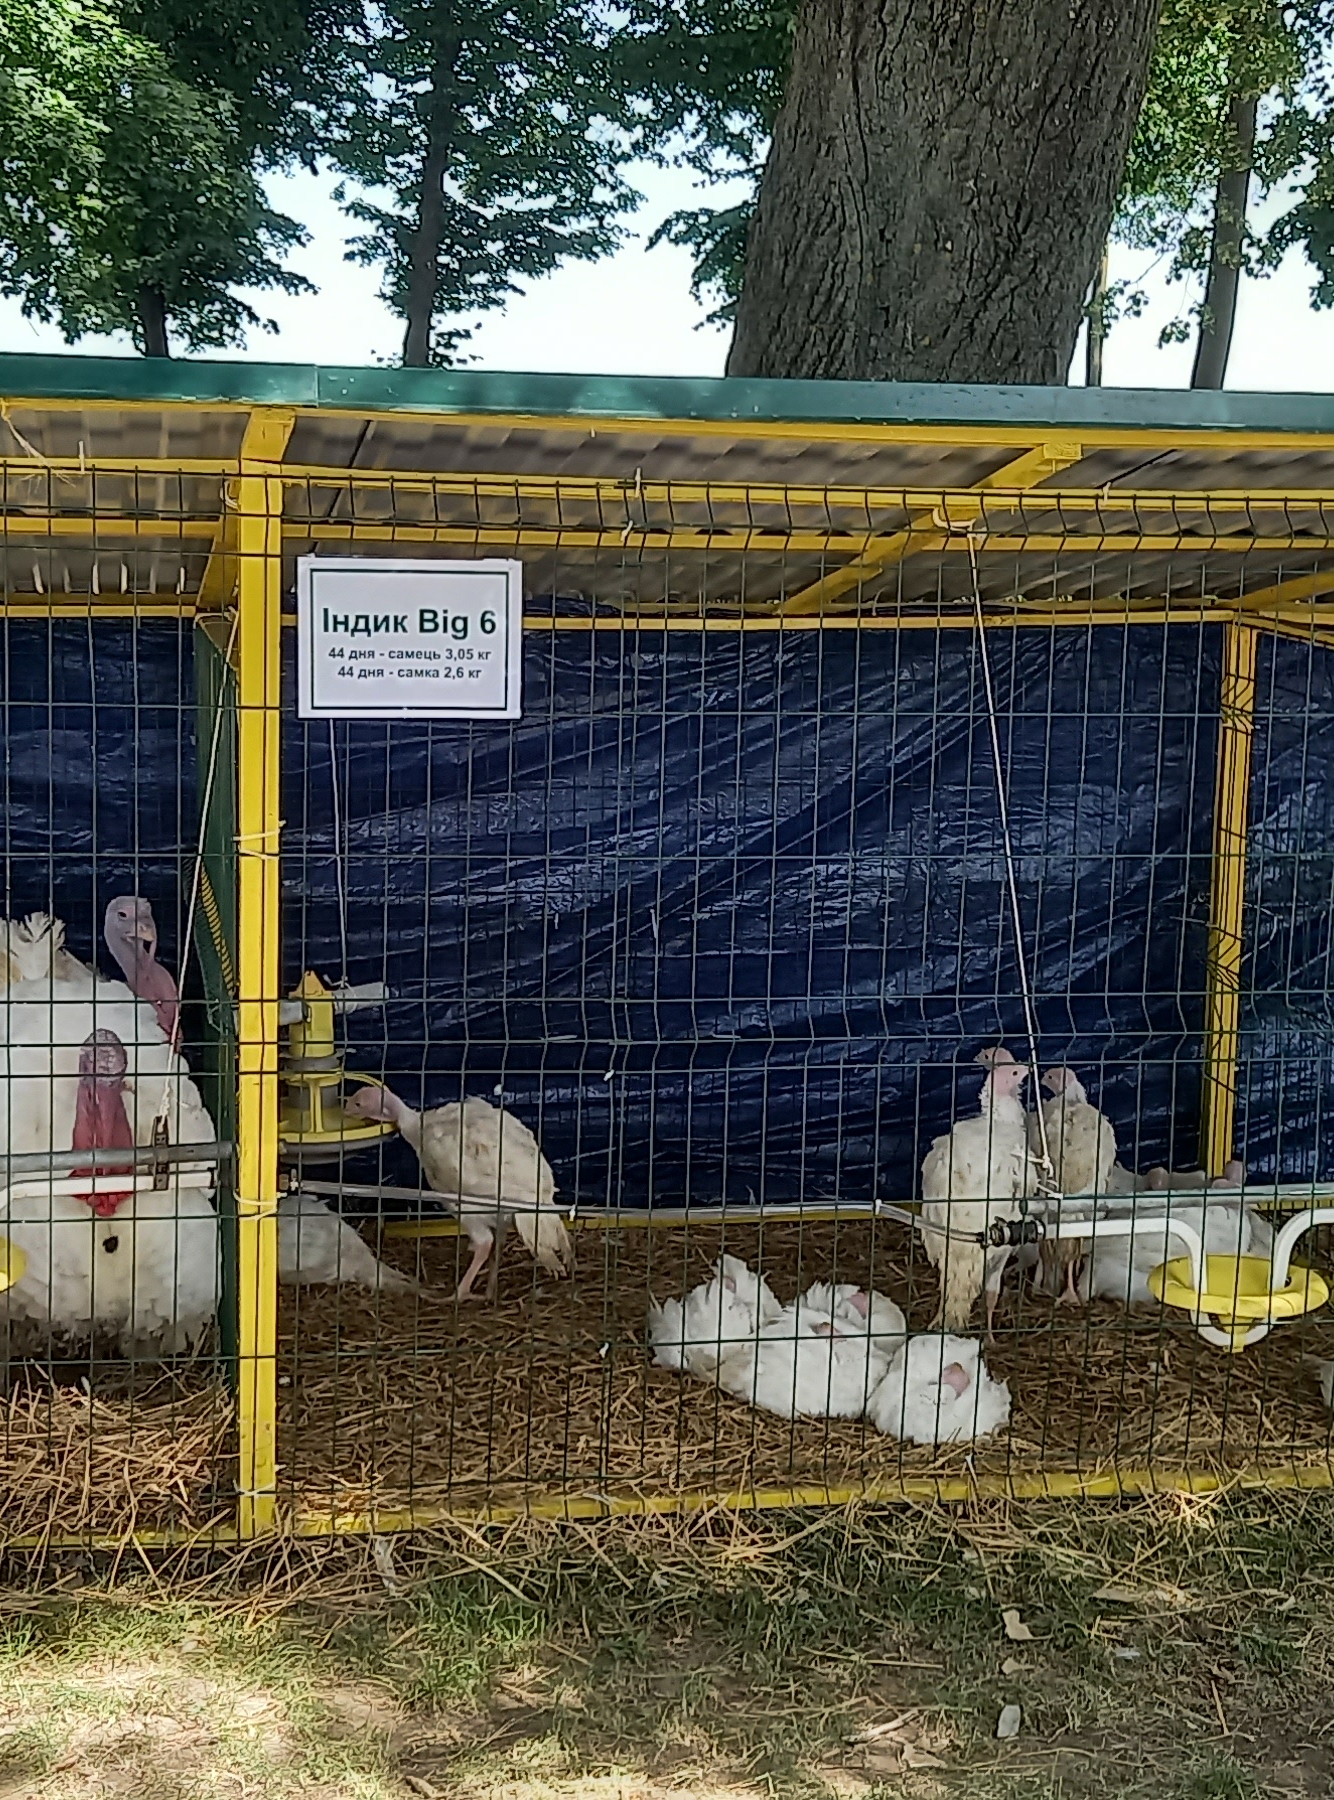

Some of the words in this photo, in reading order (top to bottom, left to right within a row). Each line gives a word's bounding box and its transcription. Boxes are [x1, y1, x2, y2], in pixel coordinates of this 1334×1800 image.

[322, 607, 409, 638] Індик
[419, 608, 469, 640] Big
[480, 610, 497, 634] 6
[328, 647, 345, 659] 44
[348, 650, 375, 660] дня
[388, 650, 441, 661] самець
[445, 648, 474, 662] 3,05
[478, 650, 492, 660] кг
[337, 666, 354, 677] 44
[358, 668, 384, 679] дня
[397, 668, 439, 678] самка
[444, 667, 464, 680] 2,6
[468, 669, 482, 679] кг
